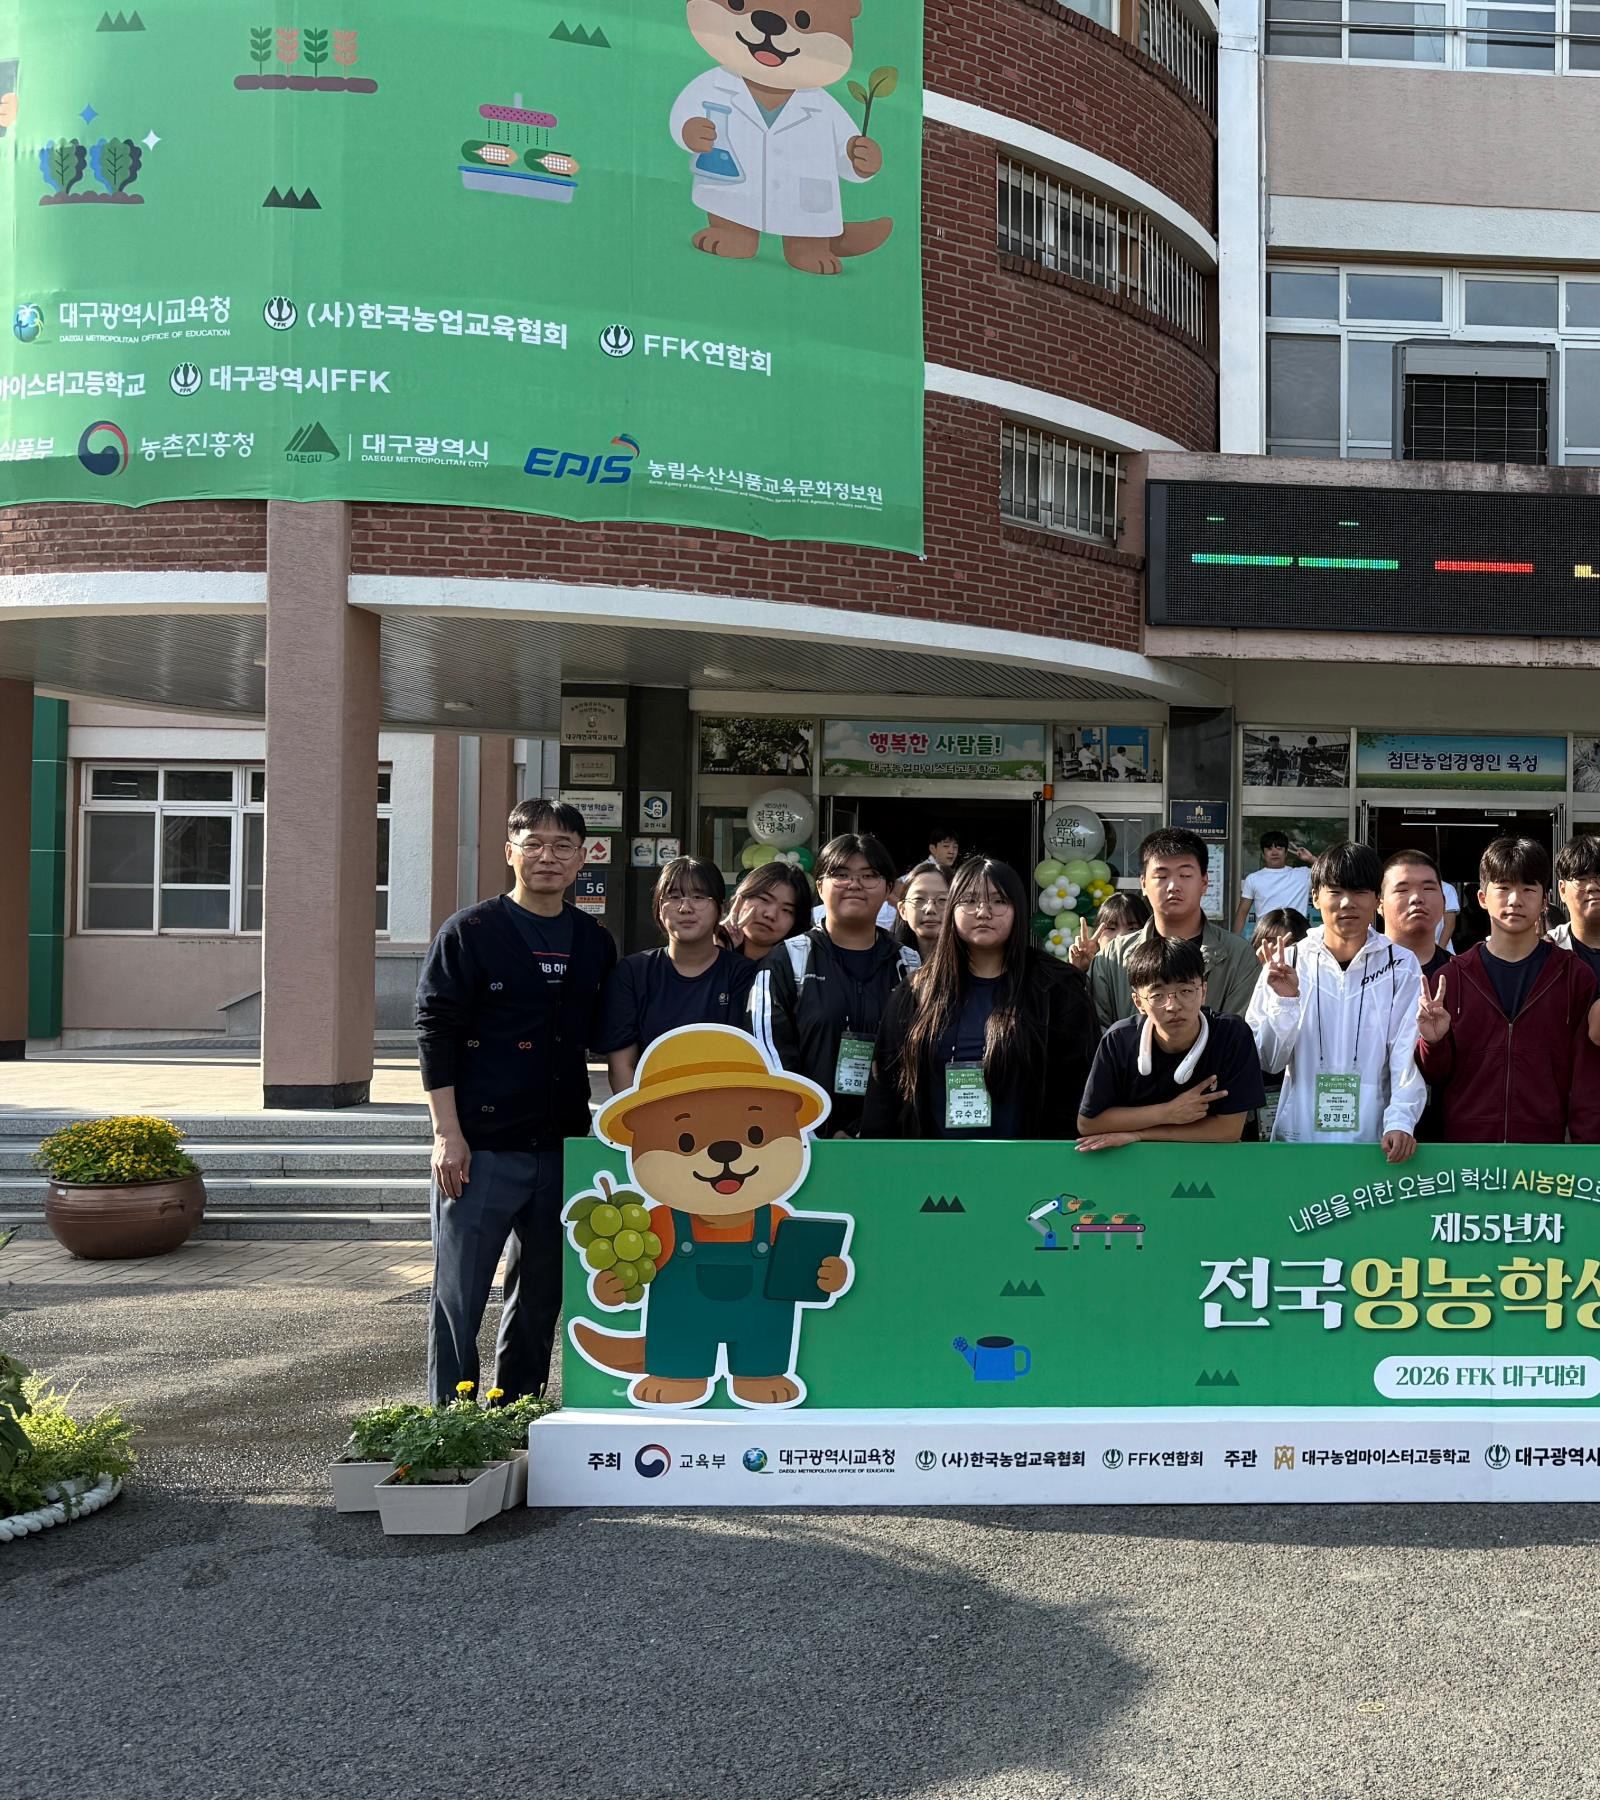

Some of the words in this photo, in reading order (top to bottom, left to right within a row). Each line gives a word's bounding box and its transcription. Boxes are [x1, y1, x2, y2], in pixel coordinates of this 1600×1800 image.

[59, 295, 230, 329] 대구광역시교육청
[307, 300, 568, 350] (사)한국농업교육협회
[59, 334, 83, 342] DAEGU
[84, 334, 139, 343] METROPOLITAN
[141, 332, 170, 342] OFFICE
[172, 331, 183, 339] OF
[185, 328, 230, 338] EDUCATION
[644, 334, 772, 376] FFK연합회
[210, 366, 391, 394] 대구광역시FFK
[140, 431, 255, 459] 농촌진흥청
[362, 433, 488, 461] 대구광역시
[286, 452, 322, 464] DAEGU
[361, 454, 392, 463] DAEGU
[394, 456, 465, 467] METROPOLITAN
[468, 460, 489, 468] CITY
[524, 447, 632, 485] EPIS
[647, 458, 883, 505] 농림수산식품교육문화정보원
[869, 732, 928, 754] 행복한
[935, 734, 1001, 755] 사람들!
[869, 763, 1000, 774] 대구농업마이스터고등학교
[1387, 750, 1501, 772] 첨단농업경영인
[1507, 752, 1539, 773] 육성
[757, 810, 795, 822] 전국영농
[1055, 818, 1080, 828] 2026
[757, 822, 796, 834] 학생축제
[1057, 828, 1075, 836] FFK
[1050, 836, 1086, 848] 대구대회
[586, 882, 604, 894] 56
[1290, 1192, 1350, 1237] 내일을
[1353, 1180, 1394, 1212] 위한
[1397, 1171, 1456, 1203] 오늘의
[1460, 1167, 1508, 1192] 혁신!
[1430, 1212, 1565, 1245] 제55년차
[1395, 1366, 1450, 1387] 2026
[1455, 1367, 1497, 1387] FFK
[1502, 1364, 1587, 1389] 대구대회
[588, 1452, 621, 1471] 주최
[680, 1453, 726, 1469] 교육부
[779, 1448, 895, 1466] 대구광역시교육청
[942, 1450, 1086, 1467] (사)한국농업교육협회
[1128, 1450, 1203, 1467] FFK연합회
[1224, 1450, 1257, 1467] 주관
[1302, 1449, 1470, 1465] 대구농업마이스터고등학교
